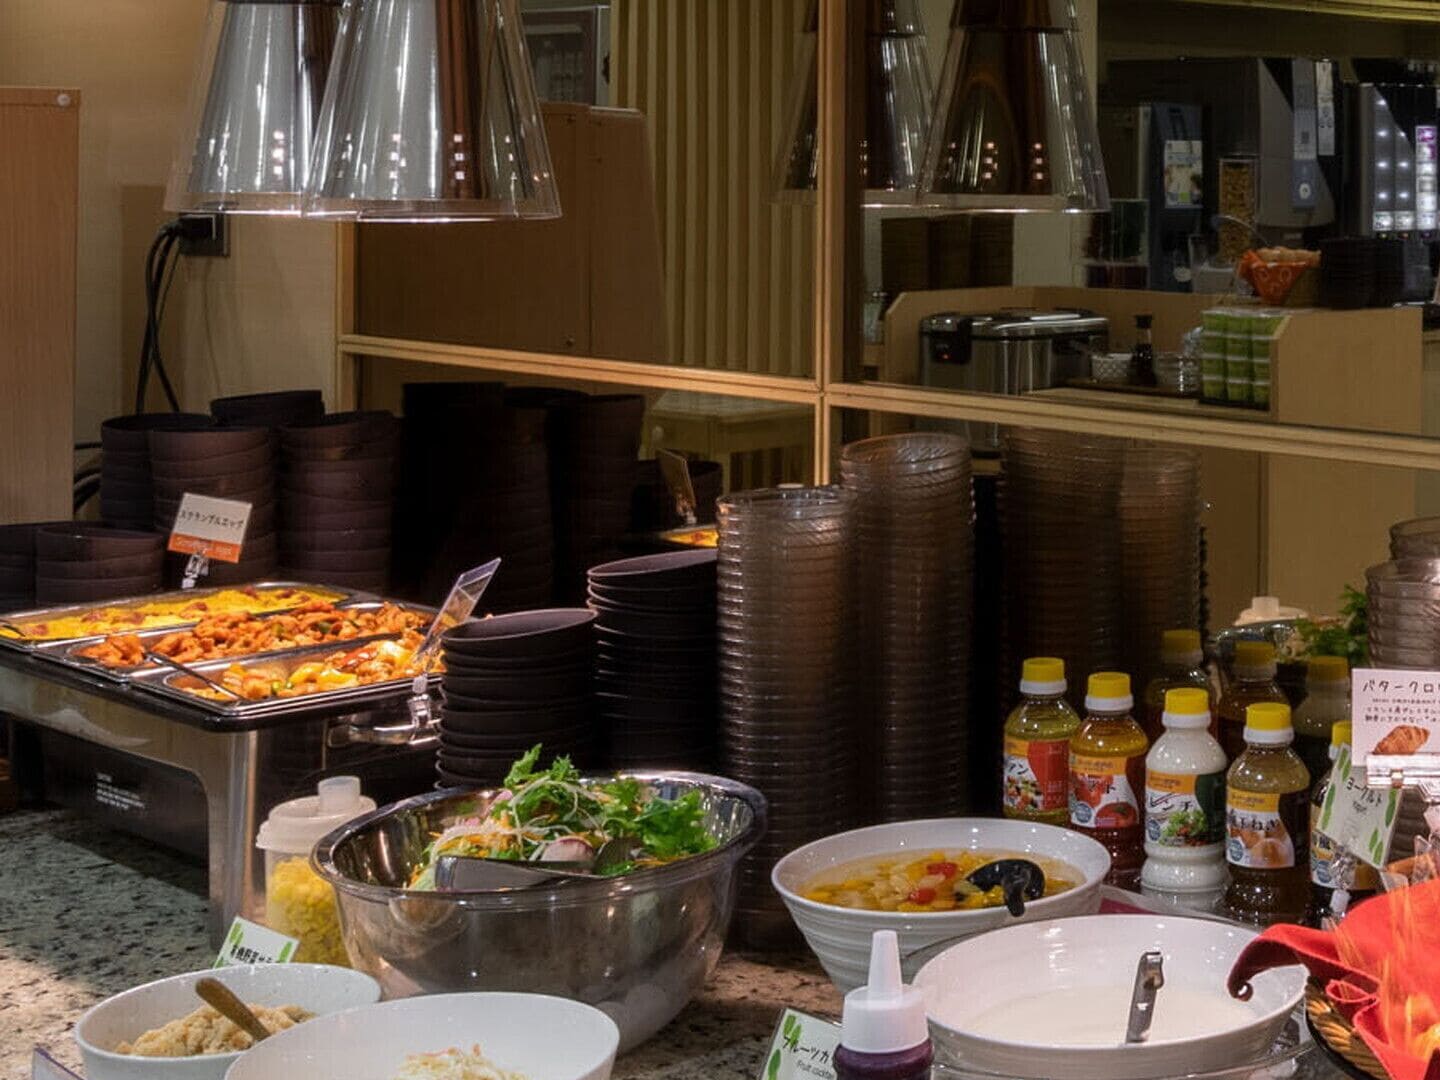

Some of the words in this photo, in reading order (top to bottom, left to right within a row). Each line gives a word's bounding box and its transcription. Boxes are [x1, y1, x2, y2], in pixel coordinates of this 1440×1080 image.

[783, 1035, 829, 1063] フルーツカ
